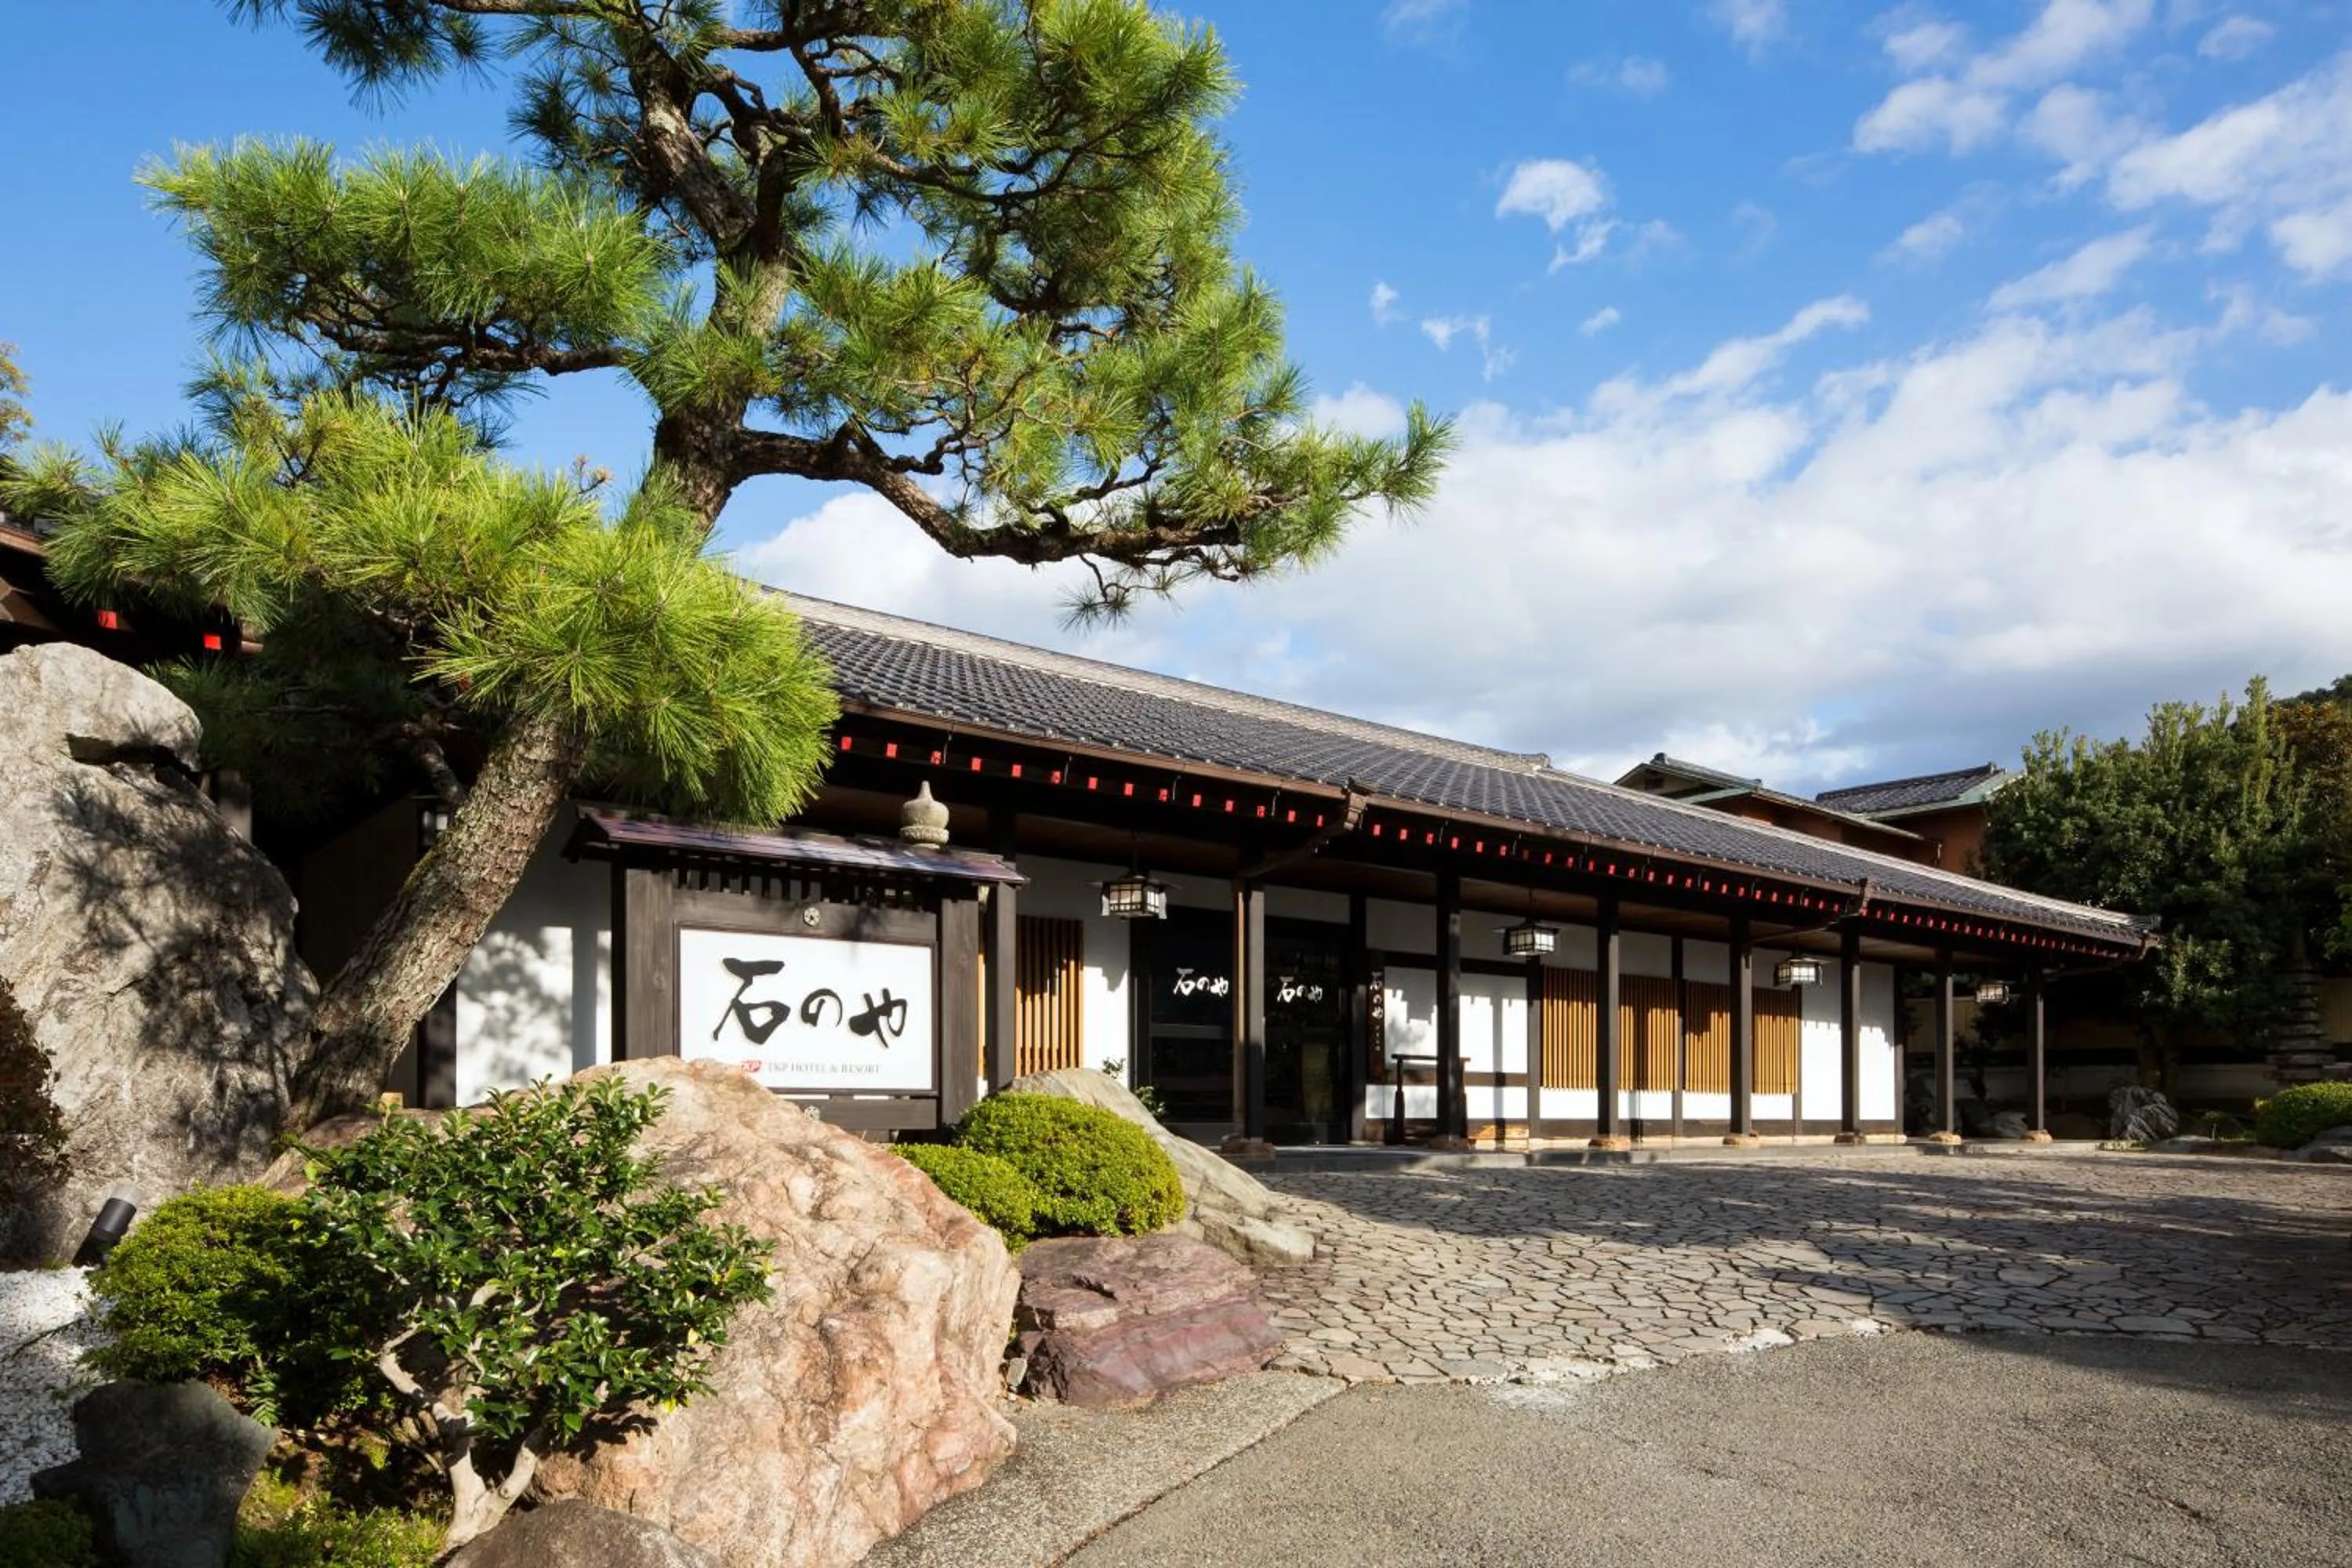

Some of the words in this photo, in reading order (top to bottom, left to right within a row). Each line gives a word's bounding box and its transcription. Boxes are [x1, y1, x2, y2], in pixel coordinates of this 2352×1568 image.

[1173, 967, 1229, 996] 石のや
[1276, 976, 1323, 1003] 石のや
[713, 957, 907, 1048] 石のや
[791, 1062, 825, 1073] HOTEL
[841, 1062, 879, 1073] RESORT
